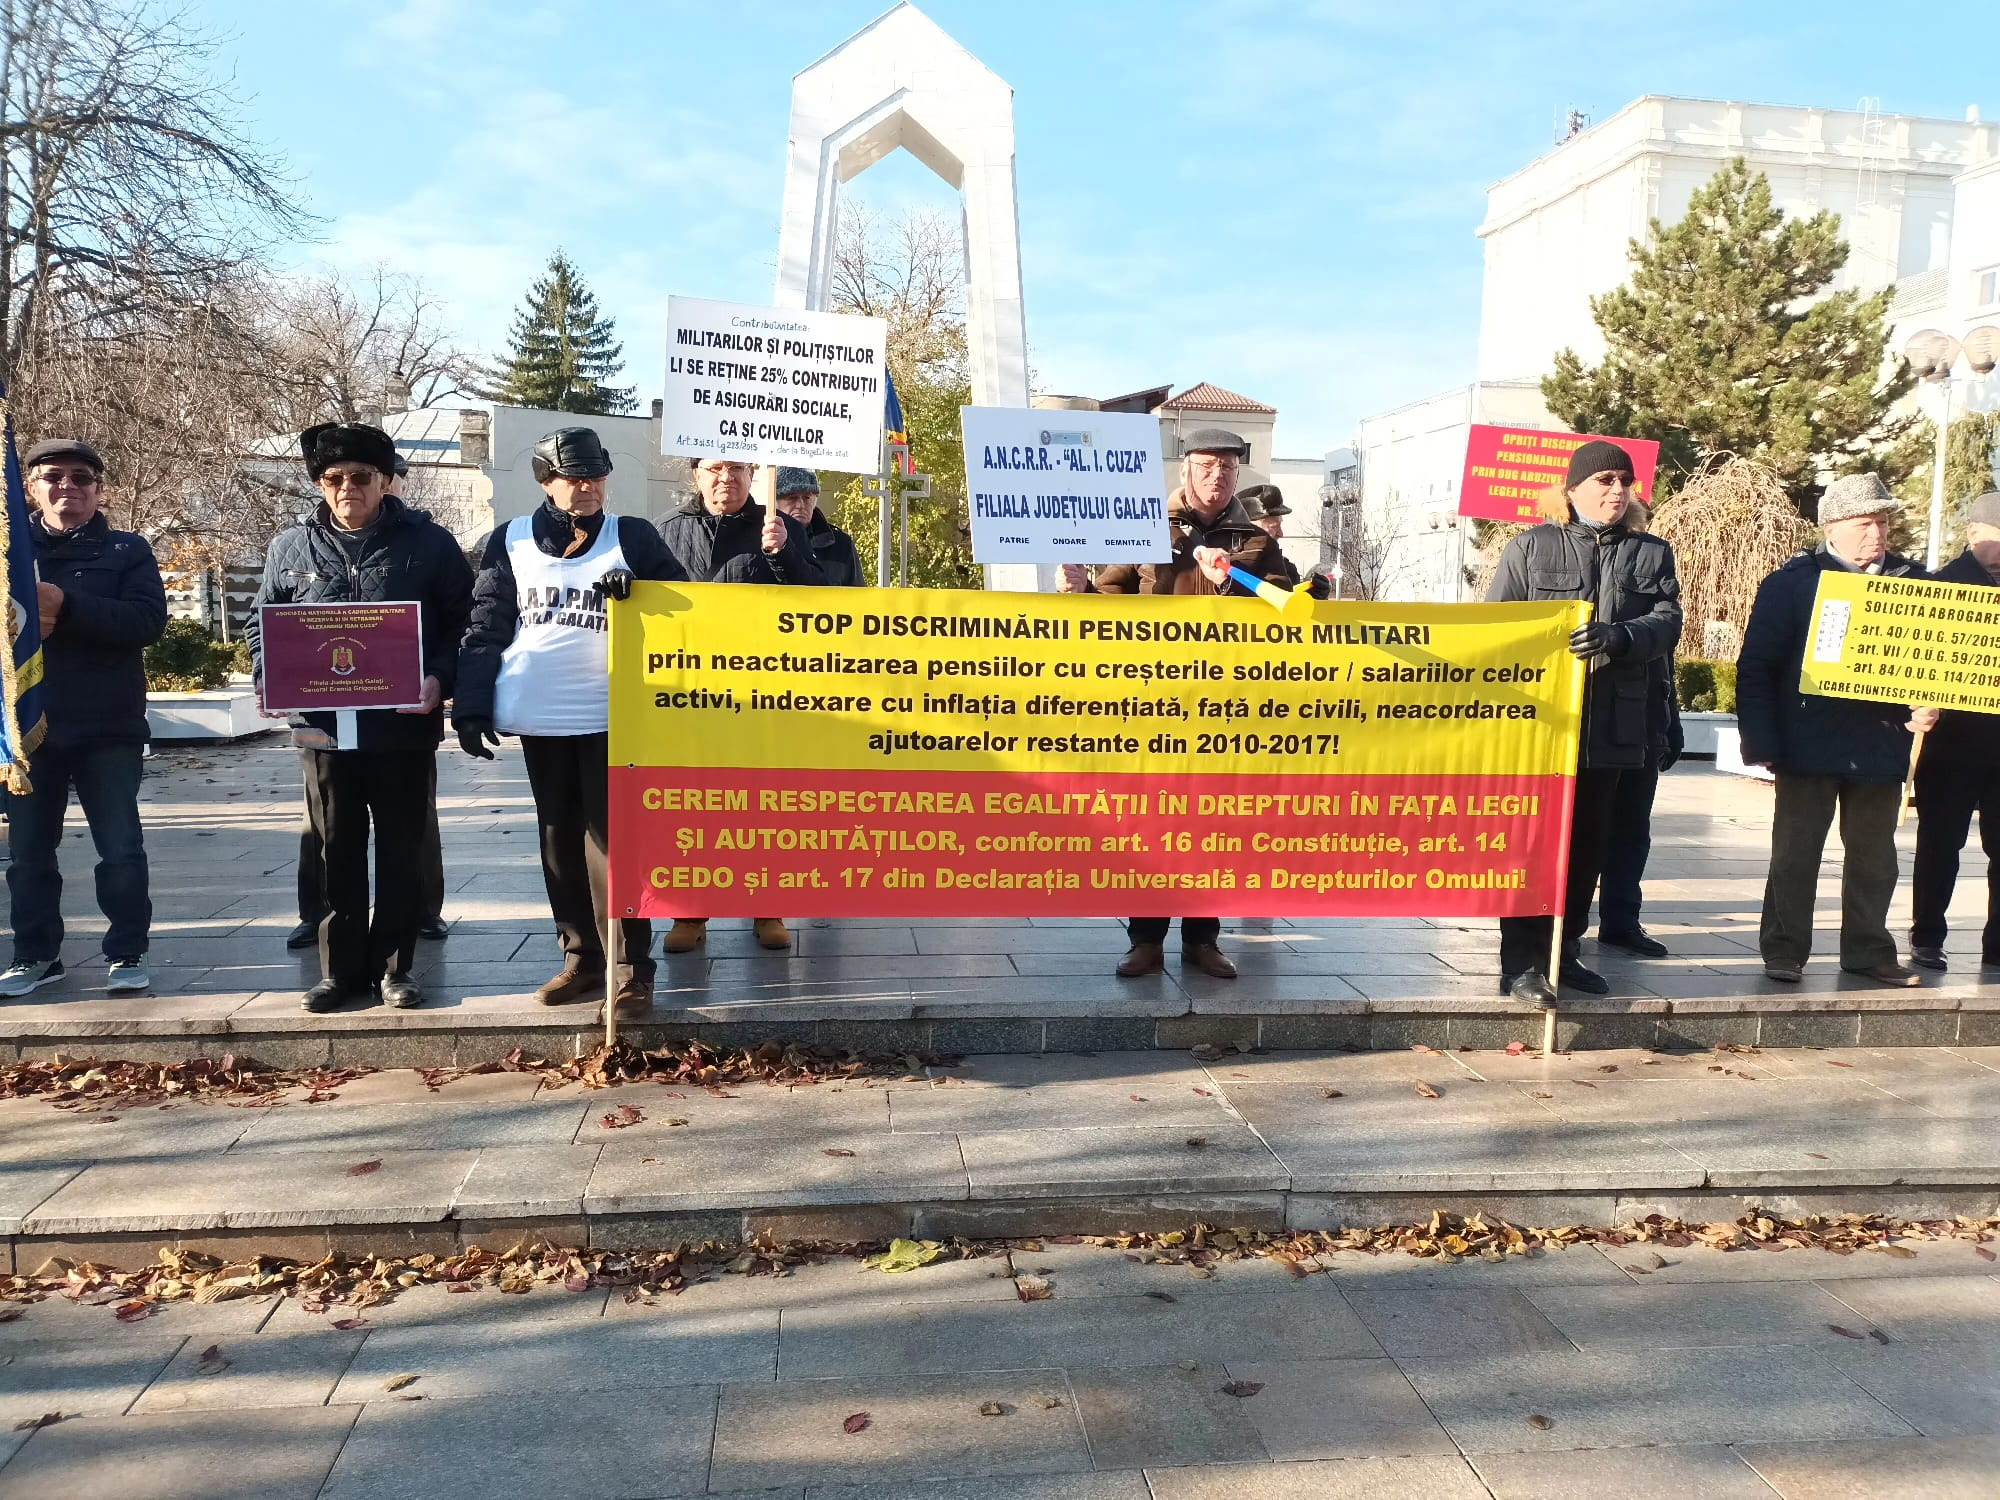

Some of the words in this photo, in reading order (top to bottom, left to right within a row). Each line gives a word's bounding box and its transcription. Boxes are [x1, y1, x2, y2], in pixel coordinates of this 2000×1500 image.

[677, 328, 763, 352] MILITARILOR
[767, 338, 780, 359] ȘI
[784, 340, 874, 365] POLIȚIȘTILOR
[670, 356, 682, 373] LI
[687, 359, 703, 375] SE
[709, 361, 756, 383] REȚINE
[761, 367, 788, 385] 25%
[792, 369, 877, 397] CONTRIBUȚII
[694, 389, 711, 405] DE
[715, 391, 787, 413] ASIGURĂRI
[792, 399, 852, 422] SOCIALE,
[719, 420, 737, 437] CA
[742, 422, 754, 443] ȘI
[758, 424, 823, 445] CIVILILOR
[984, 446, 1053, 471] A.N.C.R.R.
[1094, 450, 1103, 473] I.
[1472, 466, 1496, 478] PRIN
[1488, 485, 1518, 498] LEGEA
[976, 494, 1030, 518] FILIALA
[1034, 495, 1109, 528] JUDEȚULUI
[1113, 497, 1162, 528] GALAȚI
[1517, 505, 1533, 517] NR.
[999, 536, 1030, 544] PATRIE
[1105, 539, 1151, 547] DEMNITATE
[1867, 580, 1953, 601] PENSIONARII
[778, 612, 853, 635] STOP
[863, 613, 1069, 640] DISCRIMINĂRII
[1079, 620, 1303, 644] PENSIONARILOR
[1312, 624, 1430, 645] MILITARI
[1929, 606, 2000, 625] ABROGARE
[1861, 624, 1883, 637] art.
[1887, 626, 1909, 639] 40/
[1912, 628, 1948, 644] O.U.G.
[1951, 632, 2000, 649] 57/2015
[648, 648, 701, 674] prin
[711, 652, 918, 675] neactualizarea
[927, 656, 1046, 681] pensiilor
[1054, 662, 1086, 678] cu
[1095, 660, 1224, 685] creșterile
[1233, 660, 1339, 682] soldelor
[1346, 661, 1354, 682] /
[1362, 662, 1476, 683] salariilor
[1482, 662, 1546, 683] celor
[1858, 643, 1879, 656] art.
[1883, 645, 1900, 658] VII
[1912, 648, 1948, 663] O.U.G.
[1854, 662, 1875, 675] art.
[1879, 663, 1901, 677] 84/
[1904, 666, 1939, 681] O.U.G.
[1943, 670, 2000, 688] 114/2018
[654, 687, 741, 714] activi,
[751, 689, 872, 712] indexare
[881, 697, 913, 713] cu
[923, 692, 1016, 721] inflația
[1025, 694, 1189, 723] diferențiată,
[1197, 697, 1249, 724] față
[1258, 698, 1290, 719] de
[1298, 698, 1367, 724] civili,
[1376, 699, 1537, 720] neacordarea
[1854, 684, 1906, 699] CIUNTESC
[1909, 689, 1956, 704] PENSIILE
[868, 729, 1019, 756] ajutoarelor
[1027, 733, 1140, 754] restante
[1148, 733, 1187, 754] din
[1196, 733, 1339, 755] 2010-2017!
[642, 787, 748, 811] CEREM
[759, 789, 975, 814] RESPECTAREA
[984, 788, 1148, 822] EGALITĂȚII
[1158, 789, 1188, 815] ÎN
[1198, 794, 1341, 816] DREPTURI
[1350, 790, 1379, 816] ÎN
[1388, 795, 1458, 823] FAȚA
[1466, 795, 1539, 816] LEGII
[676, 827, 704, 857] ȘI
[714, 824, 966, 858] AUTORITĂȚILOR,
[975, 831, 1092, 852] conform
[1101, 832, 1149, 852] art.
[1160, 831, 1192, 853] 16
[1201, 832, 1242, 853] din
[1252, 832, 1409, 859] Constituție,
[1418, 832, 1465, 853] art.
[1475, 832, 1507, 852] 14
[650, 866, 734, 889] CEDO
[744, 867, 768, 896] și
[778, 868, 829, 889] art.
[840, 867, 874, 888] 17
[883, 867, 925, 889] din
[935, 868, 1080, 895] Declarația
[1090, 868, 1236, 889] Universală
[1245, 873, 1261, 889] a
[1270, 868, 1418, 894] Drepturilor
[1425, 868, 1527, 890] Omului!
